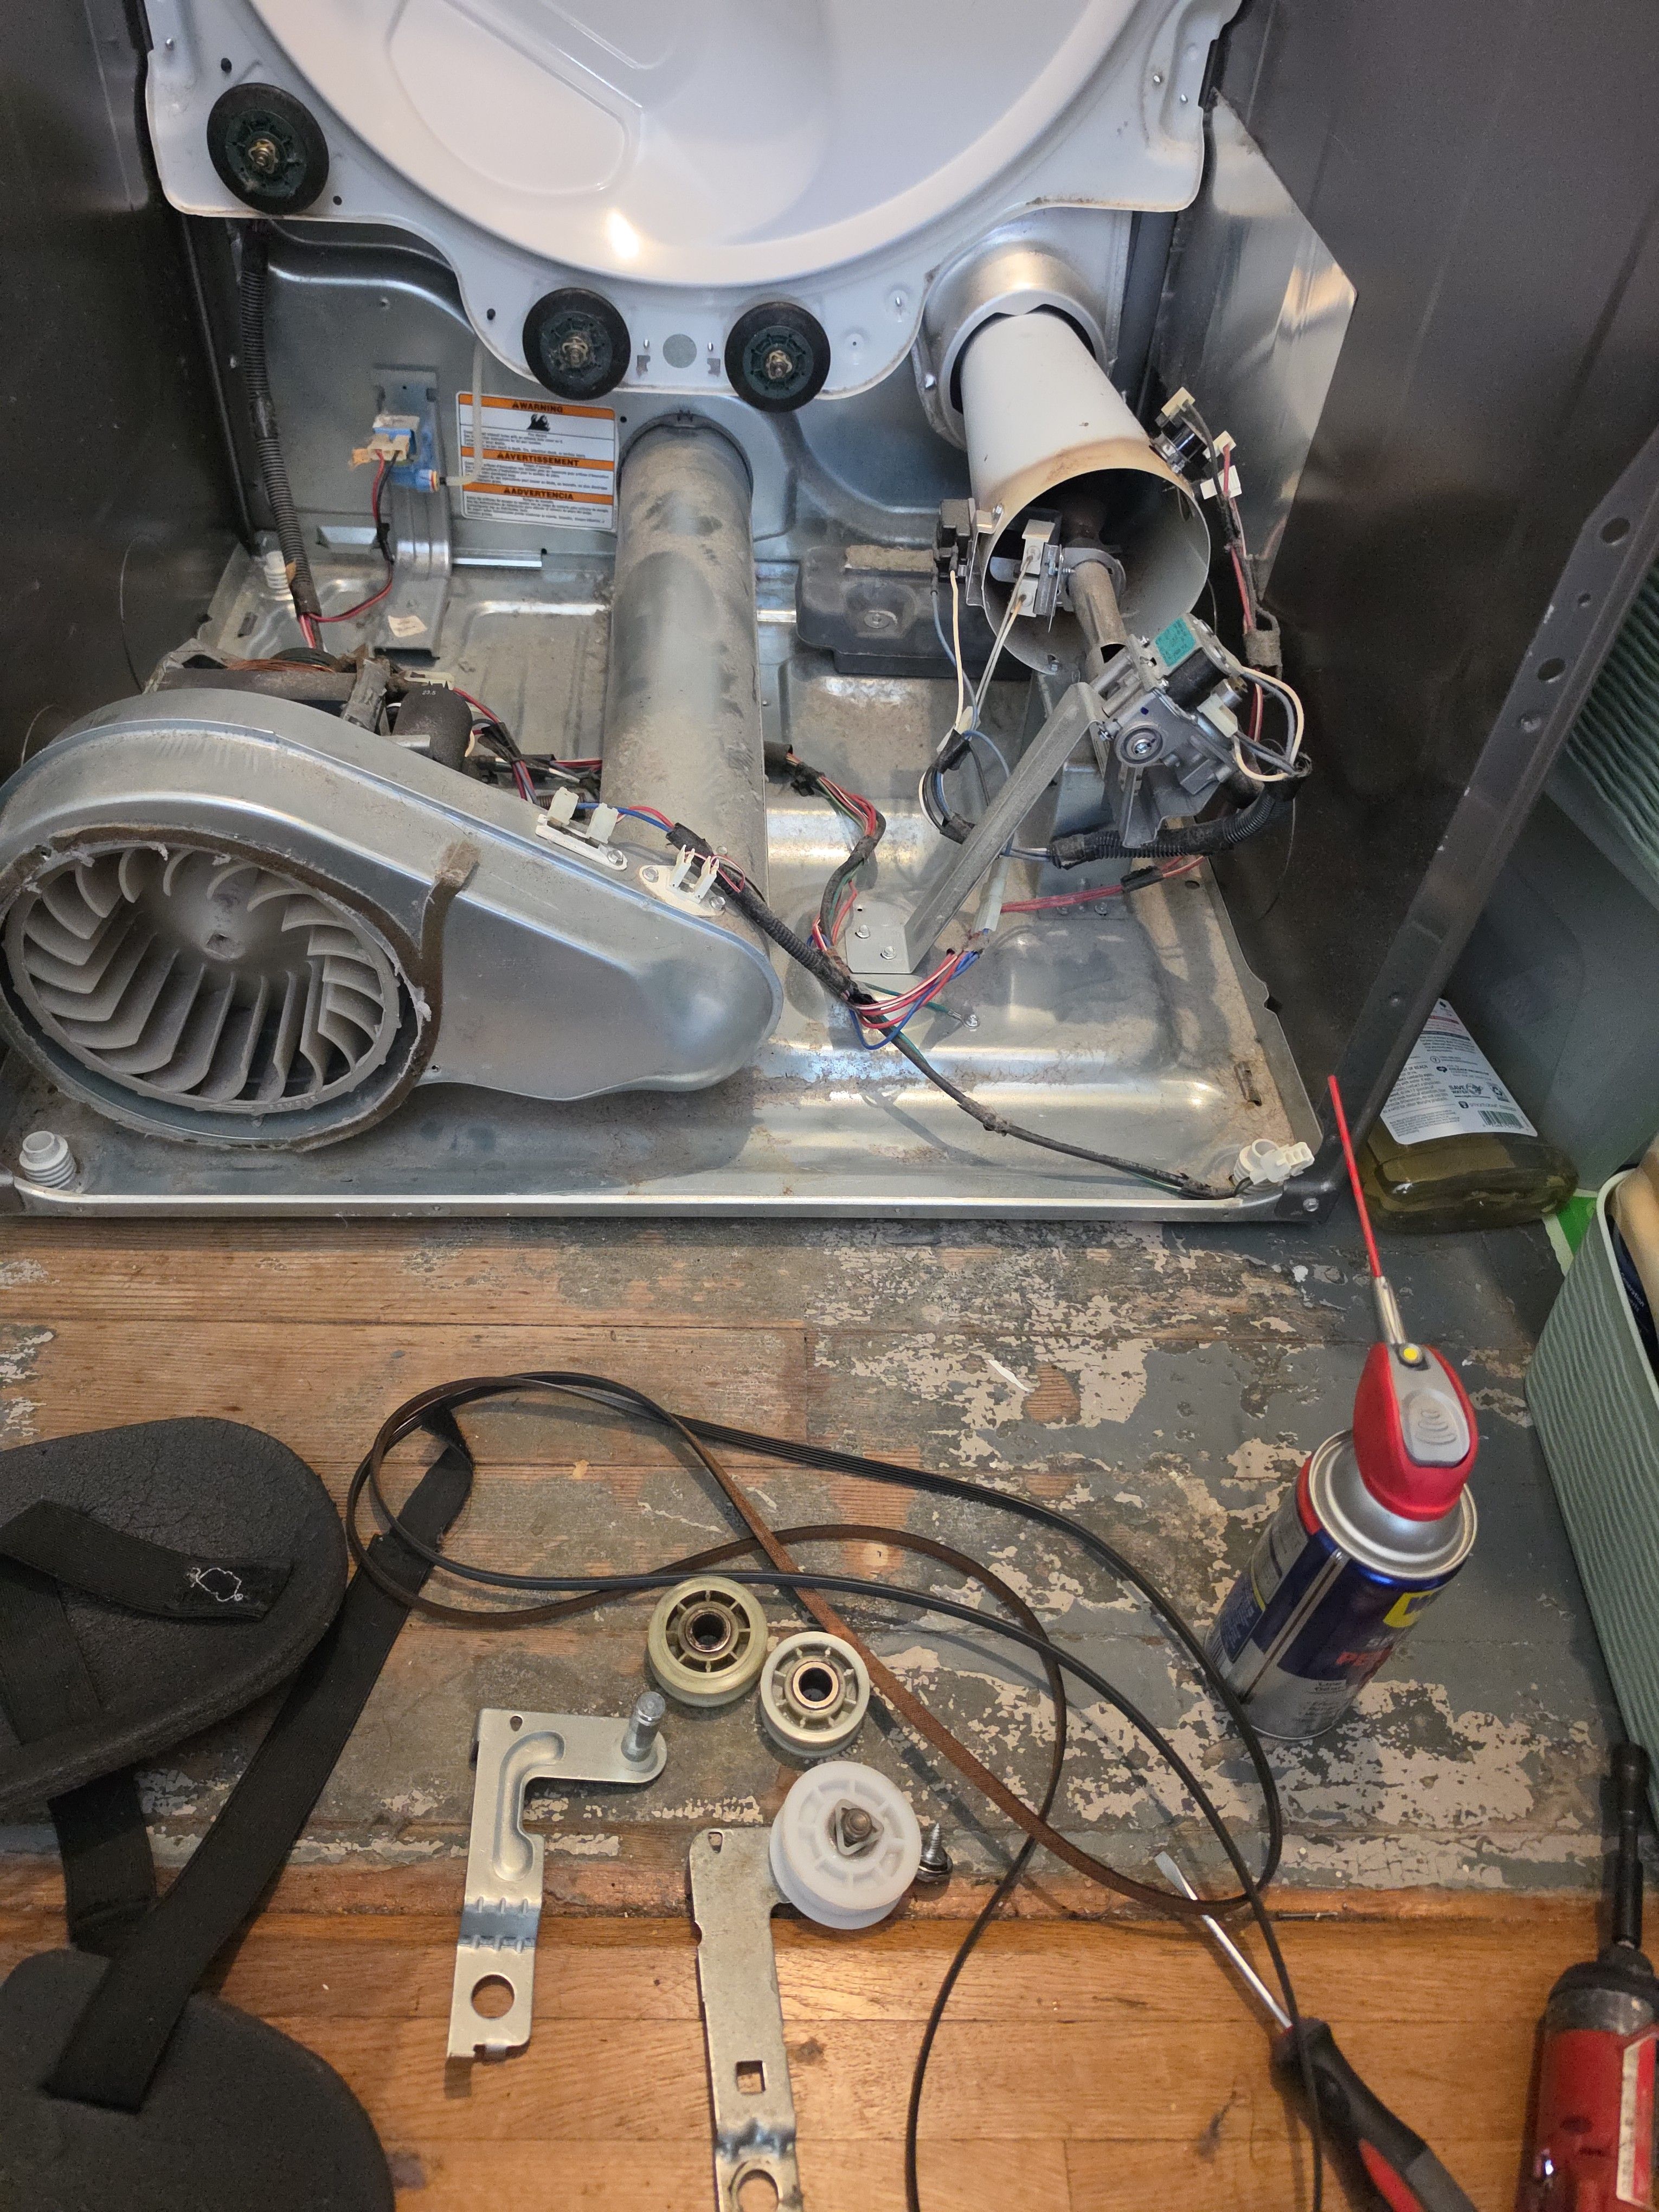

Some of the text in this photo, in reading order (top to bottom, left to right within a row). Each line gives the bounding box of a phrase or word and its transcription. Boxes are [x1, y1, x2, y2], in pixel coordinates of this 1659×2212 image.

[520, 402, 563, 413] WARNING
[505, 452, 580, 466] AVERTISSEMENT
[511, 488, 573, 500] ADVERTENCIA
